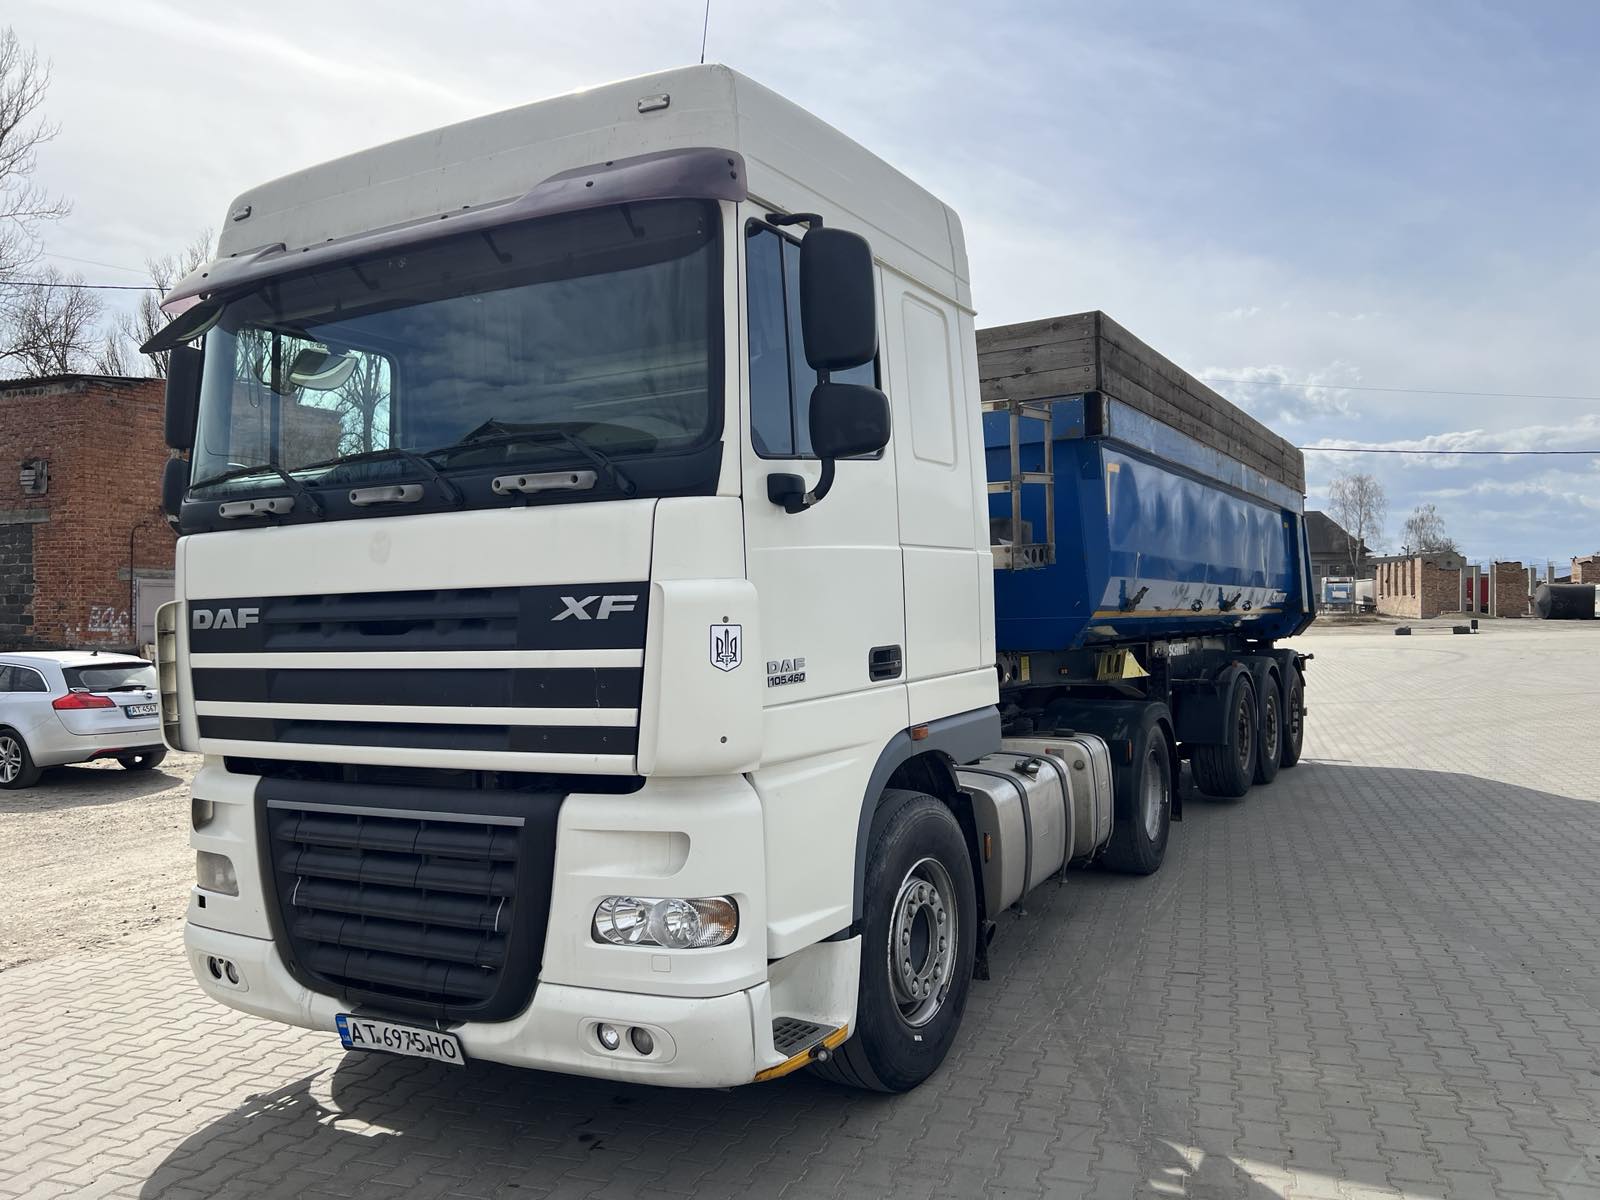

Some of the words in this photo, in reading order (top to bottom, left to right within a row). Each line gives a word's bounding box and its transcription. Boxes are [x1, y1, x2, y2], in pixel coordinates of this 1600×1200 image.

[192, 607, 260, 630] DAF
[550, 594, 639, 621] XF
[766, 657, 806, 674] DAF
[352, 1022, 377, 1044] AT
[383, 1027, 426, 1053] 6975
[427, 1034, 457, 1059] HO
